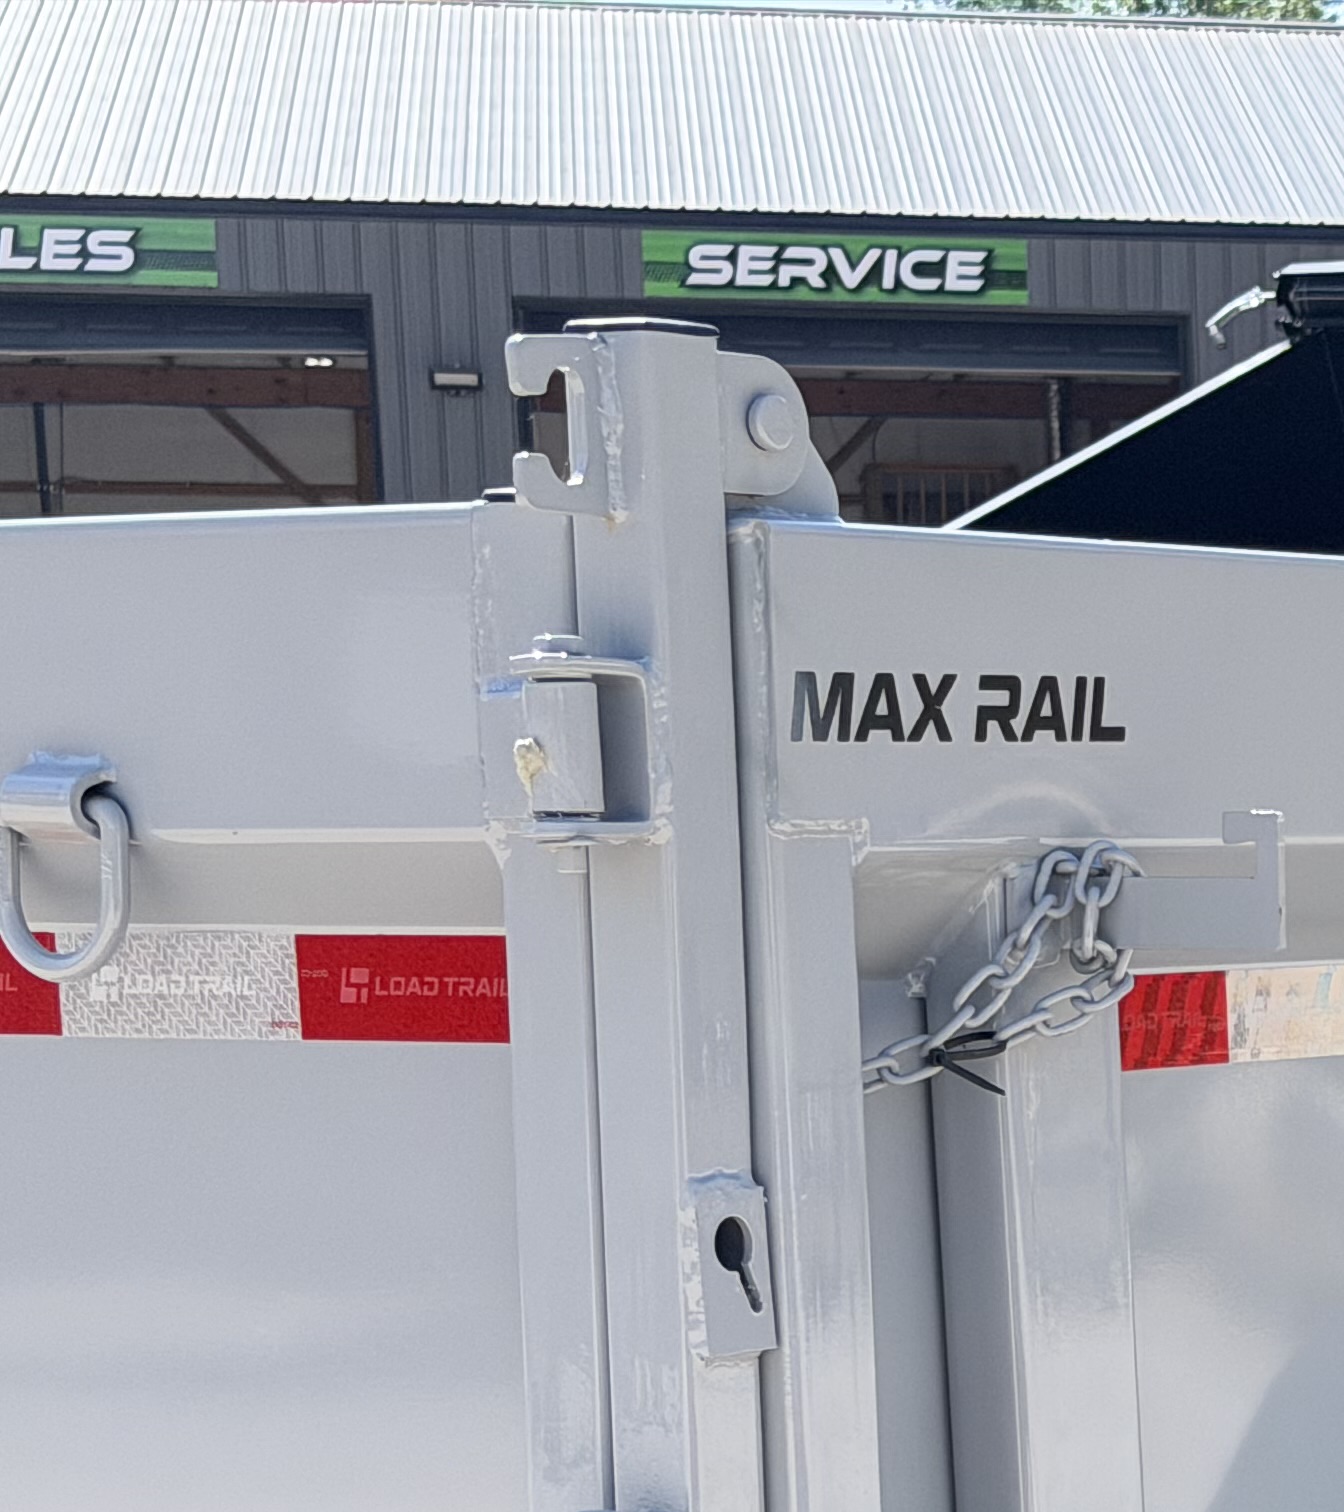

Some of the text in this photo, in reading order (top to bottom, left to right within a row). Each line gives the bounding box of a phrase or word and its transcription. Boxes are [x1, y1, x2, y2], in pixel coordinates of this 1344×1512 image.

[684, 243, 989, 292] SERVICE
[790, 670, 1126, 742] MAX RAIL
